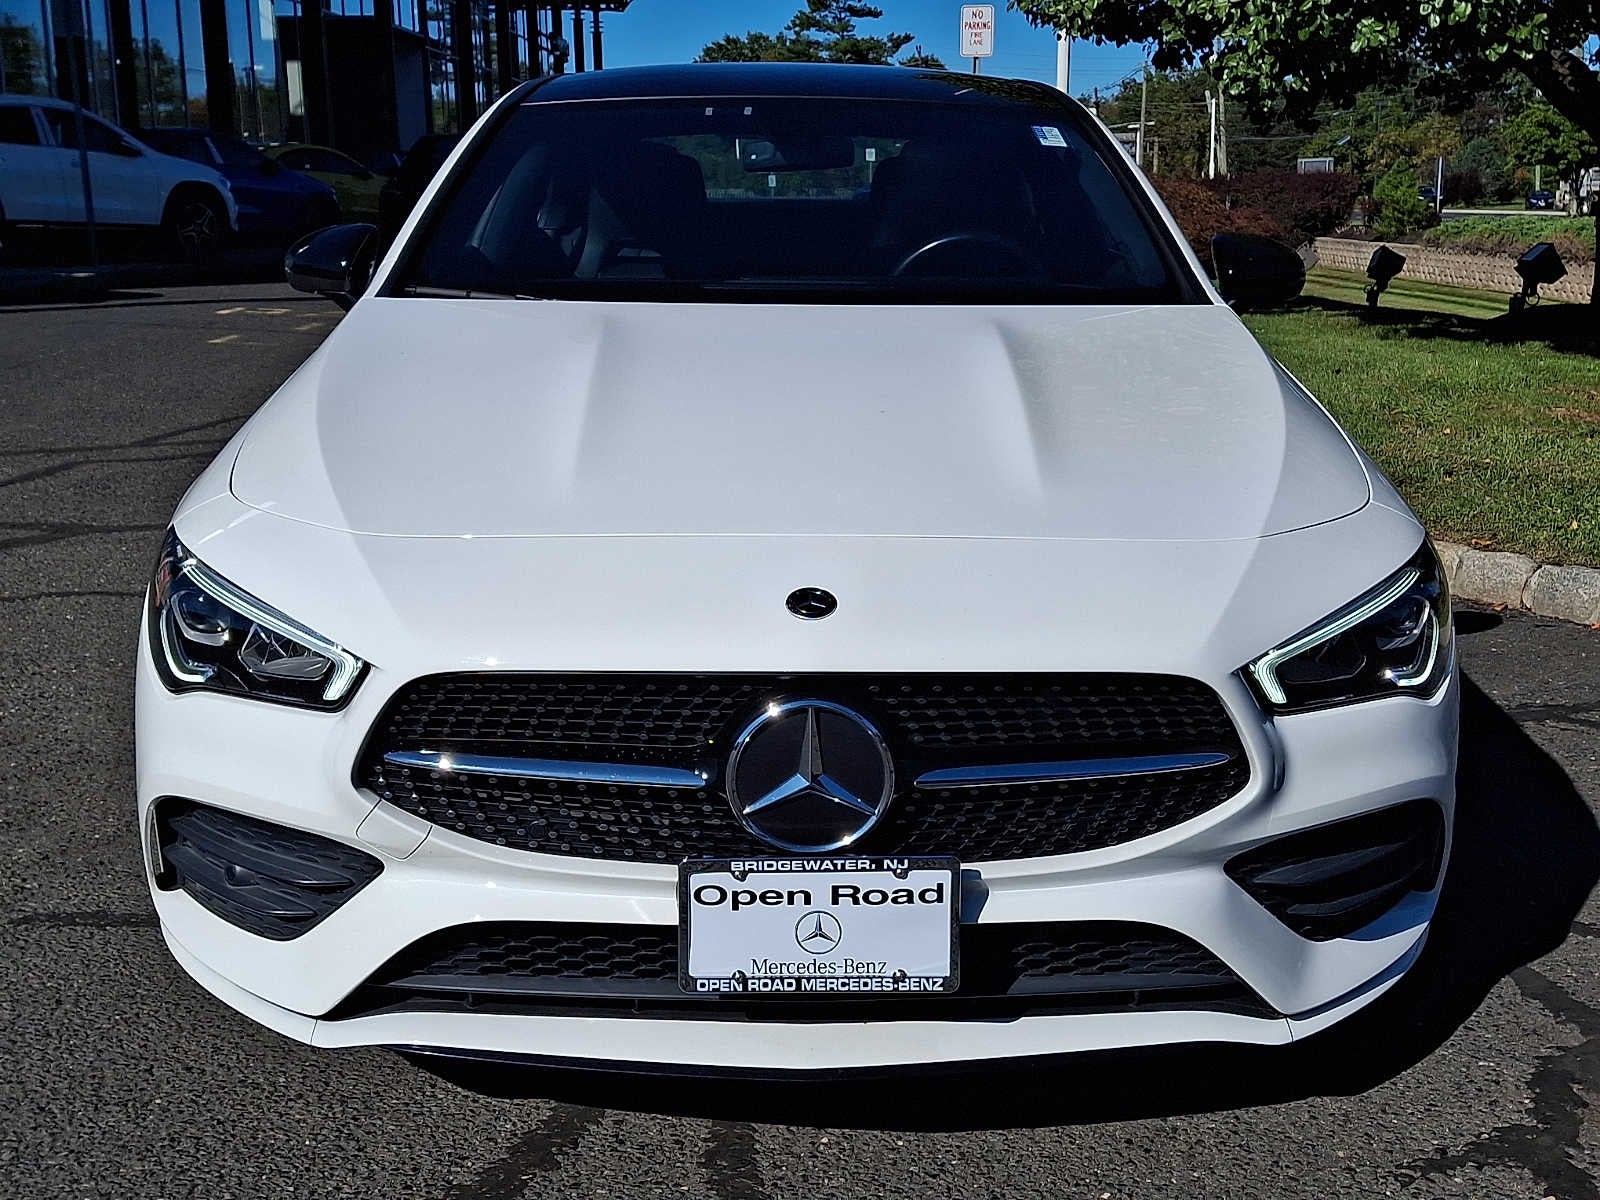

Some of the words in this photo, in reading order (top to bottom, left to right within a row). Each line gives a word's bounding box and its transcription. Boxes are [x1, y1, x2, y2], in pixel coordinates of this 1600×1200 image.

[971, 10, 984, 20] NO
[964, 21, 991, 30] PARKING
[730, 859, 876, 871] BRIDGEWATER,
[883, 858, 909, 870] NJ
[693, 884, 812, 911] Open
[831, 882, 944, 906] Road
[751, 958, 888, 975] Mercedes-Benz
[696, 978, 743, 992] OPEN
[748, 978, 797, 992] ROAD
